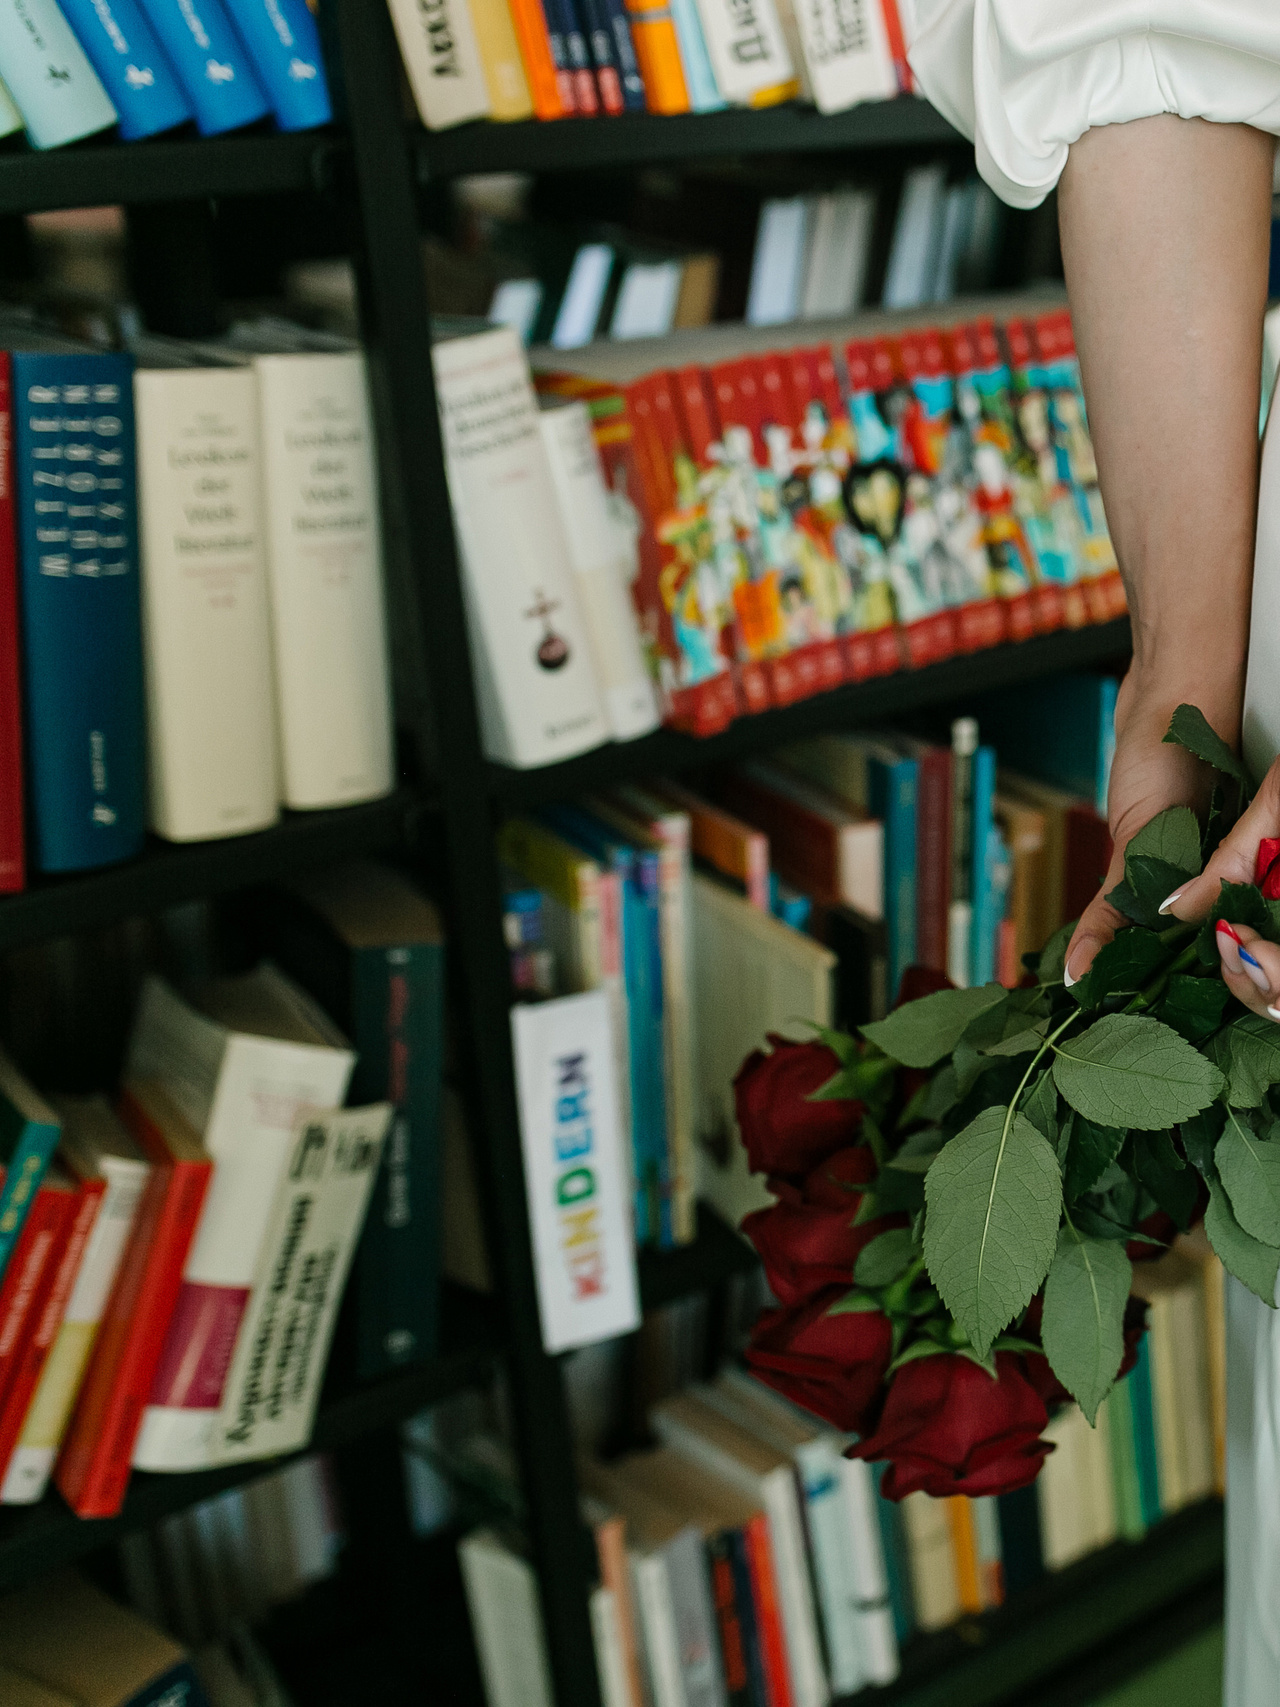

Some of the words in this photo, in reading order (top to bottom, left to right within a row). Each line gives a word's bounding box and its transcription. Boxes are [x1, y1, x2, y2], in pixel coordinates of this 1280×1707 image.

[28, 384, 71, 577] METZLER
[61, 384, 100, 578] AUTOREN
[92, 384, 129, 576] LEXIKON
[555, 1051, 608, 1301] KINDERN
